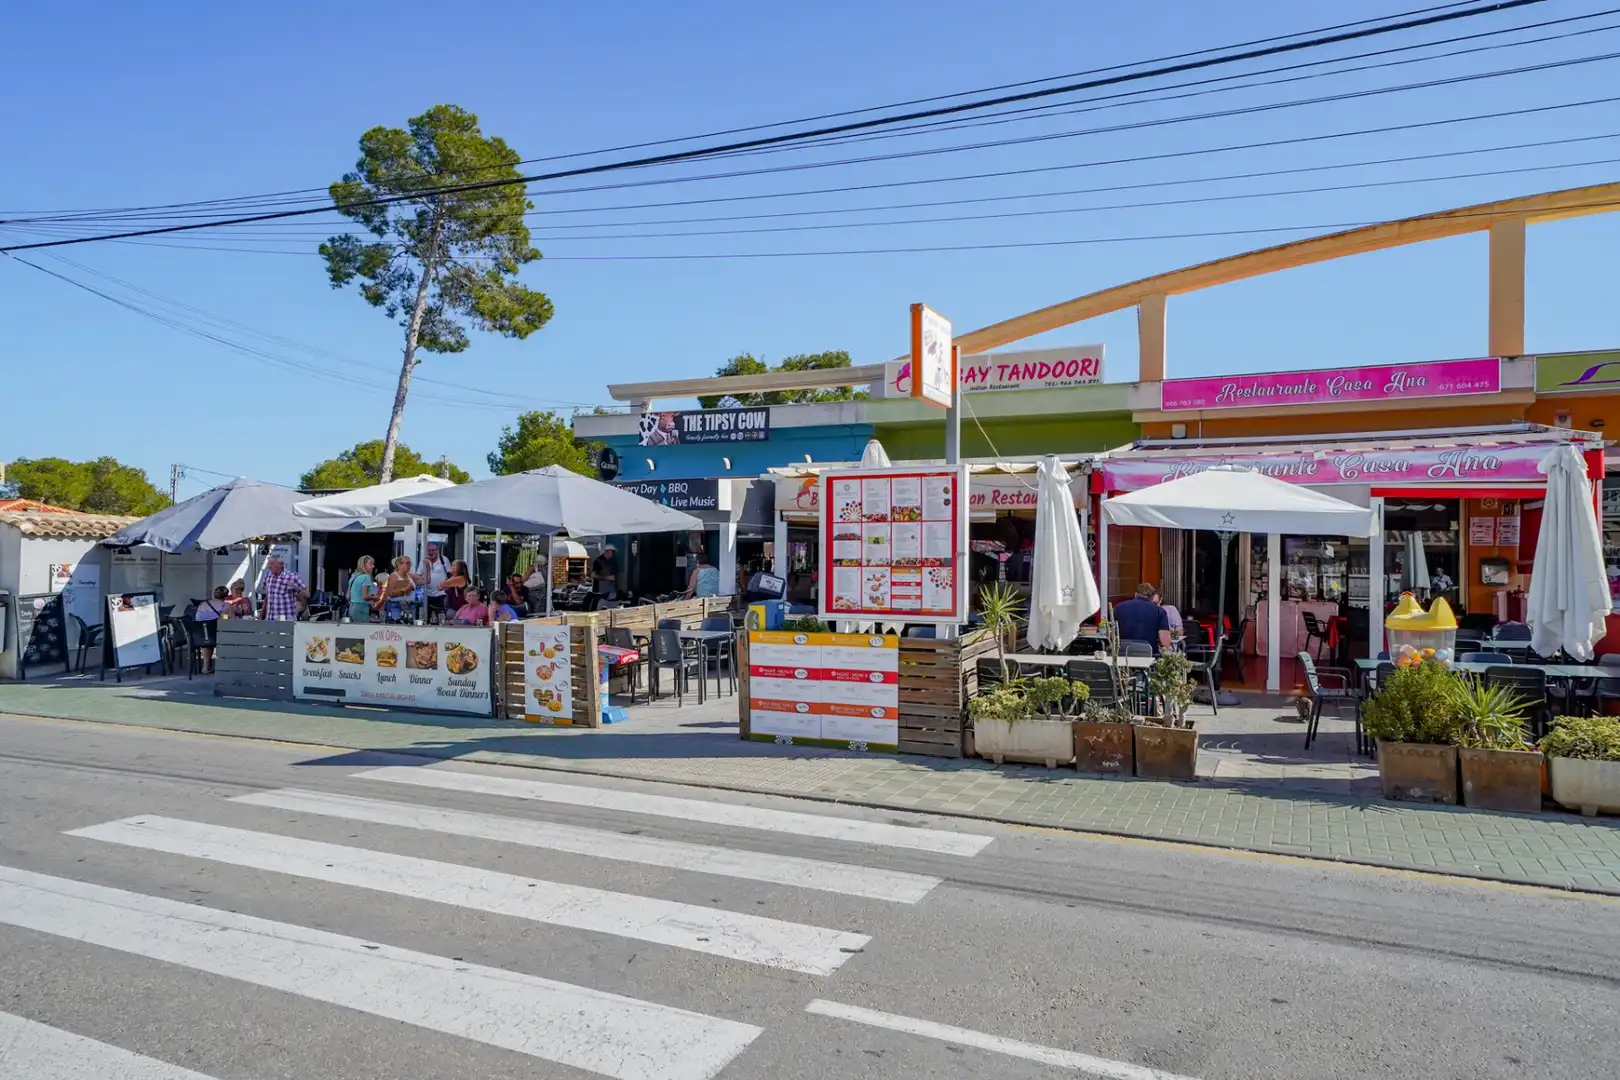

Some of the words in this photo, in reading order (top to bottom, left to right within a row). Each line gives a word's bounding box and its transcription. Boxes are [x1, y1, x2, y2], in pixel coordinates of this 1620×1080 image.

[997, 357, 1100, 381] TANDOORI
[1216, 378, 1317, 403] Restaurante
[1326, 376, 1372, 397] Casa
[1384, 371, 1428, 393] Ana
[1456, 382, 1472, 390] 604
[1474, 380, 1490, 389] 475
[683, 414, 703, 432] THE
[704, 412, 737, 431] TIPSY
[738, 411, 767, 430] COW
[1333, 453, 1413, 481] Casa
[1427, 448, 1503, 479] Ana
[640, 483, 658, 495] Day
[668, 482, 689, 494] BBQ
[670, 496, 689, 507] Live
[689, 496, 716, 507] Music
[369, 630, 384, 640] NOW
[386, 629, 403, 641] OPEN
[302, 668, 333, 680] Breakfast
[338, 669, 362, 680] Snacks
[376, 671, 397, 684] Lunch
[409, 674, 433, 684] Dinner
[447, 676, 477, 690] Sunday
[436, 686, 457, 697] Roast
[458, 688, 489, 700] Dinners
